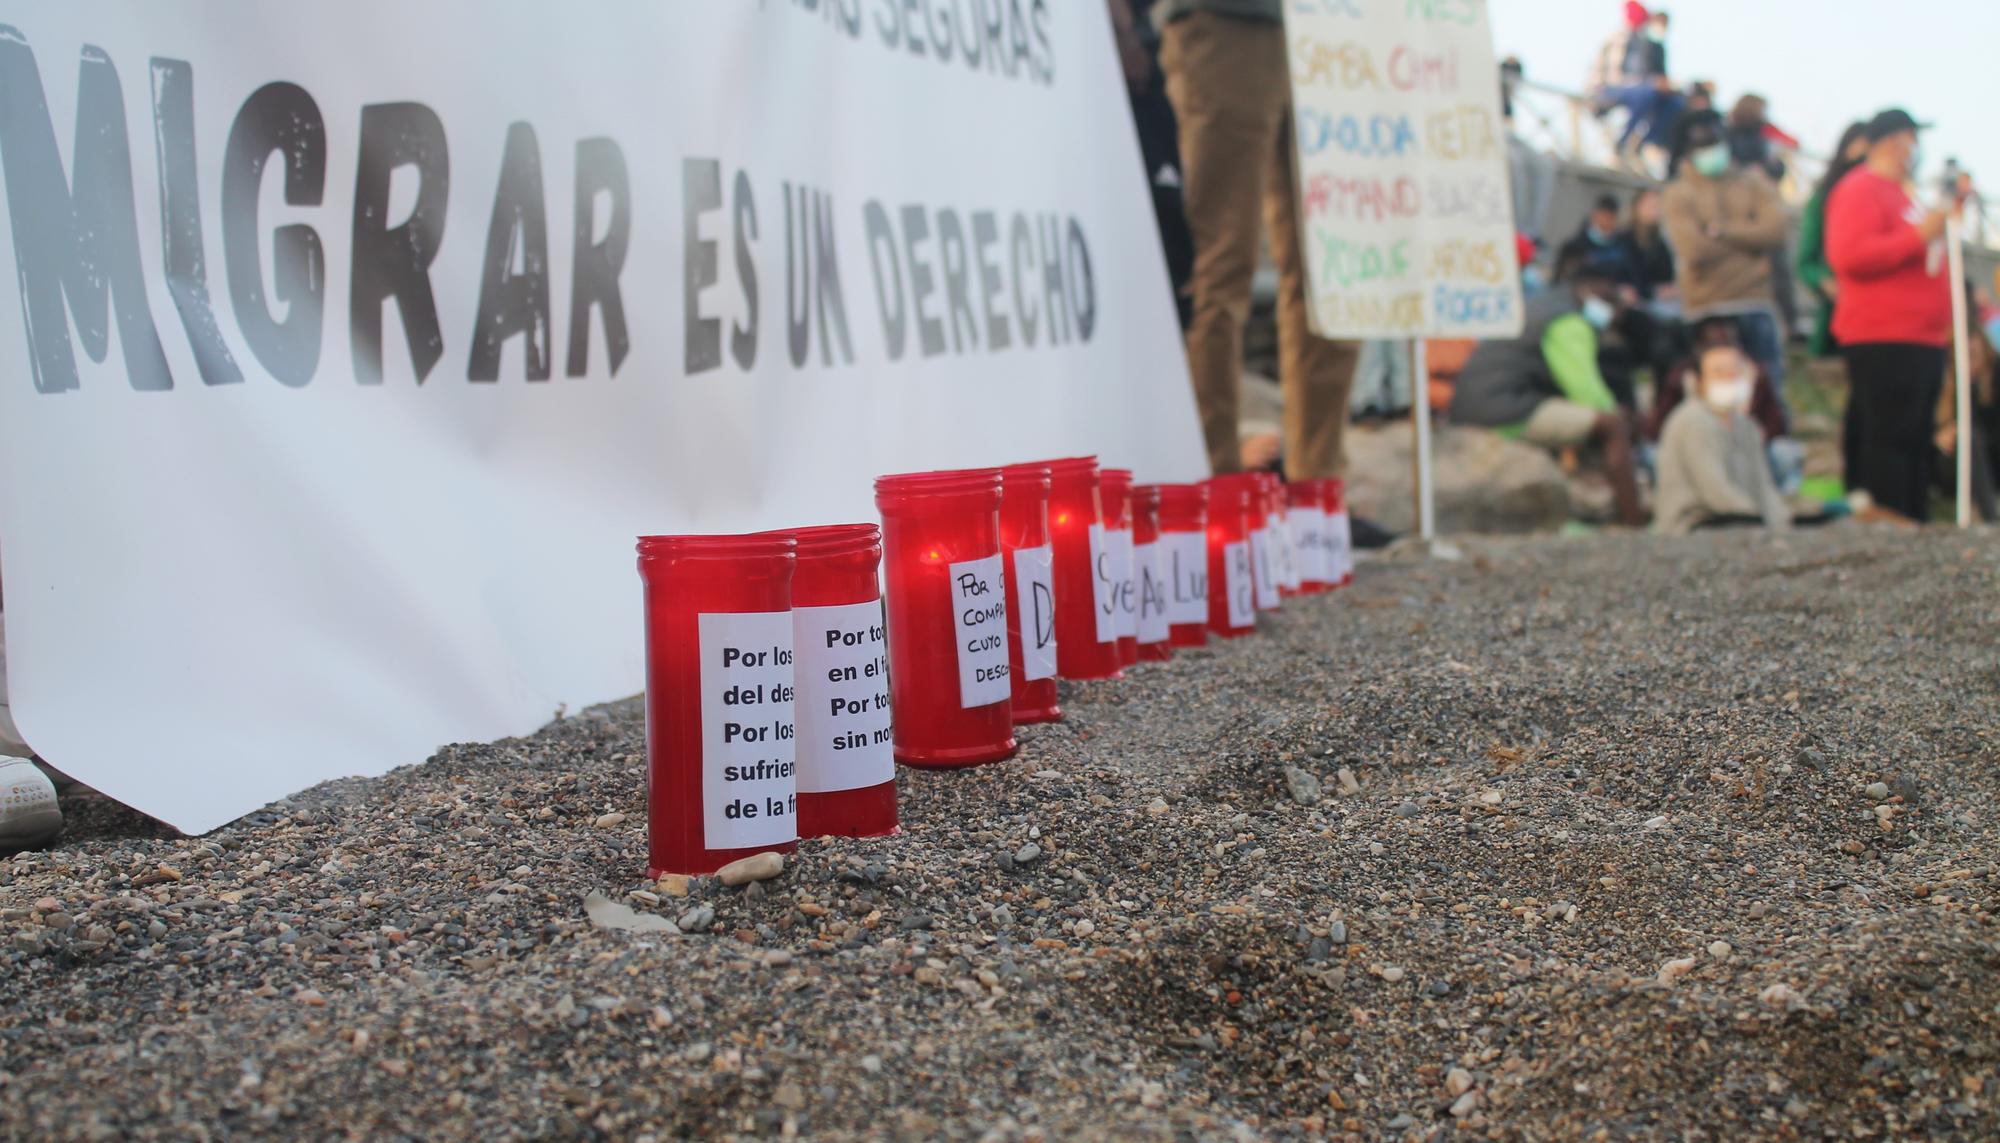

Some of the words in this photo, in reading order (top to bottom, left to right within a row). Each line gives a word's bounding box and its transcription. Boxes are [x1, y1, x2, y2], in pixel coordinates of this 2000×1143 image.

[0, 22, 631, 394] MIGRAR
[682, 157, 759, 377] ES
[781, 180, 857, 371] UN
[861, 198, 1096, 363] DERECHO
[826, 629, 864, 648] Por
[967, 635, 1001, 653] CUYO
[723, 648, 767, 668] Por
[774, 646, 793, 666] los
[828, 665, 857, 682] en
[864, 658, 878, 677] el
[723, 684, 763, 705] del
[771, 683, 794, 703] des
[831, 697, 869, 716] Por
[724, 723, 768, 743] Por
[775, 721, 794, 741] los
[833, 731, 867, 750] sin
[725, 799, 758, 819] de
[766, 797, 784, 817] la
